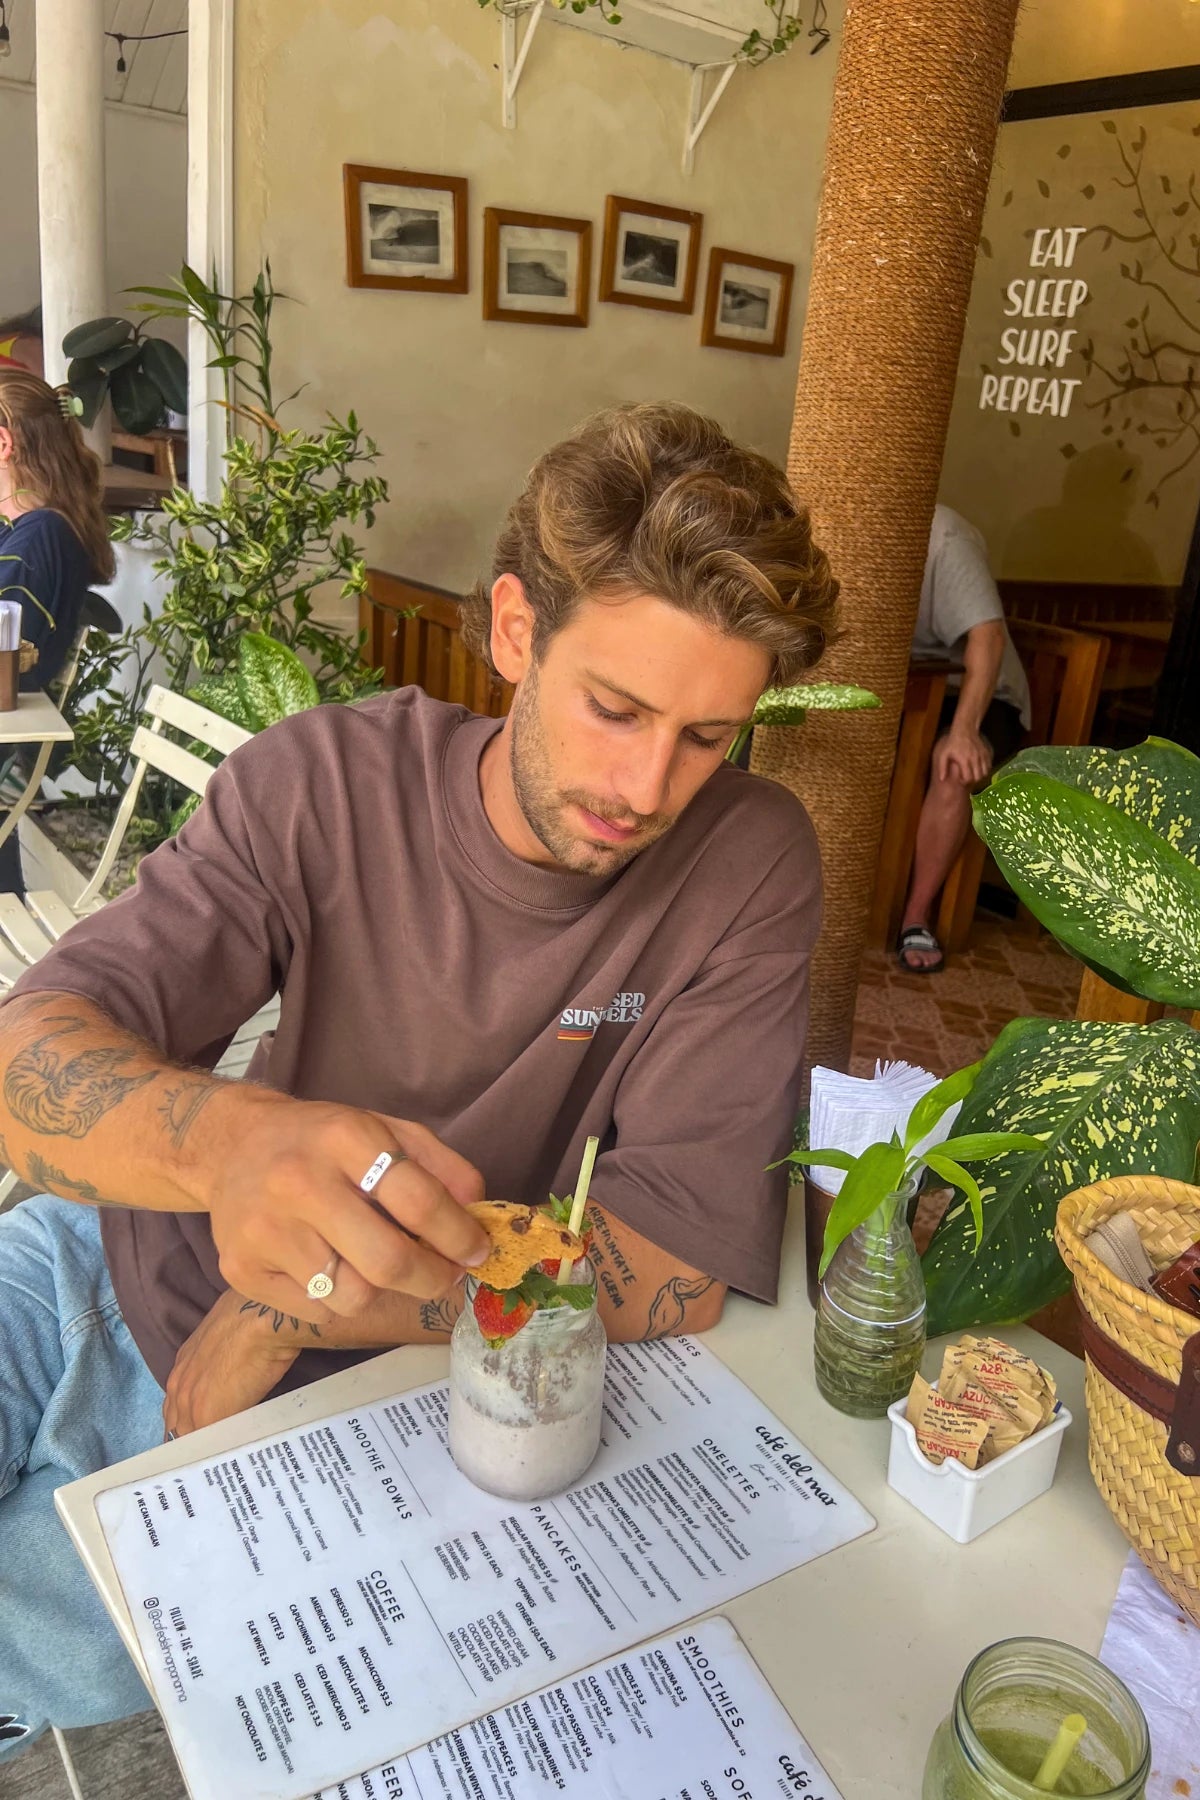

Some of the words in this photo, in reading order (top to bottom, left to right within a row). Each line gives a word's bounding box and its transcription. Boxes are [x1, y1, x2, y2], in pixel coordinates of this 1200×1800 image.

[1029, 227, 1087, 268] EAT
[1003, 279, 1088, 318] SLEEP
[997, 327, 1078, 368] SURF
[979, 374, 1083, 417] REPEAT
[610, 992, 646, 1007] SED
[280, 1440, 294, 1458] BOCAS
[288, 1457, 302, 1473] BOWL
[322, 1426, 337, 1445] PURPLE
[332, 1443, 348, 1465] DREAMS
[752, 1422, 791, 1453] café
[779, 1450, 814, 1477] del
[802, 1476, 838, 1509] mar
[229, 1459, 245, 1484] TROPICAL
[239, 1483, 254, 1504] WINTER
[346, 1417, 385, 1472] SMOOTHIE
[379, 1476, 413, 1521] BOWLS
[669, 1451, 691, 1473] SPINACH
[686, 1472, 701, 1485] FETA
[696, 1484, 723, 1511] OMELETTE
[700, 1437, 761, 1500] OMELETTES
[136, 1497, 146, 1508] WE
[156, 1491, 170, 1511] VEGAN
[176, 1484, 195, 1518] VEGETARIAN
[641, 1463, 667, 1492] CARIBBEAN
[663, 1490, 688, 1518] OMELETTE
[139, 1507, 150, 1520] CAN
[143, 1518, 153, 1529] DO
[616, 1506, 642, 1535] OMELETTE
[146, 1526, 160, 1548] VEGAN
[452, 1537, 471, 1561] BANANA
[469, 1530, 487, 1551] FRUITS
[487, 1559, 504, 1578] EACH)
[507, 1515, 529, 1542] REGULAR
[523, 1540, 548, 1571] PANCAKES
[528, 1505, 582, 1573] PANCAKES
[433, 1544, 458, 1580] BLUEBERRIES
[442, 1541, 471, 1581] STRAWBERRIES
[498, 1519, 518, 1543] Pancakes
[515, 1547, 533, 1565] Maple
[526, 1563, 543, 1581] Syrup
[541, 1584, 558, 1604] Butter
[329, 1586, 350, 1618] ESPRESSO
[343, 1617, 354, 1627] $2
[368, 1569, 405, 1623] COFFEE
[512, 1577, 537, 1608] TOPPINGS
[662, 1580, 682, 1602] Coconut
[167, 1605, 187, 1633] FOLLOW
[245, 1619, 259, 1636] FLAT
[267, 1611, 281, 1632] LATTE
[275, 1630, 285, 1641] $3
[288, 1603, 313, 1646] CAPUCHINNO
[306, 1644, 317, 1655] $3
[308, 1594, 332, 1634] AMERICANO
[325, 1632, 336, 1642] $3
[495, 1609, 517, 1638] WHIPPED
[511, 1636, 530, 1659] CREAM
[513, 1601, 535, 1627] OTHERS
[538, 1640, 556, 1662] EACH)
[145, 1606, 191, 1705] @cafedelmarpanama
[178, 1636, 194, 1652] TAG
[251, 1634, 267, 1658] WHITE
[260, 1655, 271, 1666] $4
[446, 1630, 467, 1660] NUTELLA
[456, 1626, 483, 1664] CHOCOLATE
[476, 1662, 494, 1684] SYRUP
[466, 1621, 489, 1654] COCONUT
[483, 1652, 502, 1676] FLAKES
[475, 1617, 494, 1640] SLICED
[487, 1638, 512, 1671] ALMONDS
[485, 1613, 512, 1651] CHOCOLATE
[506, 1648, 523, 1668] CHIPS
[184, 1654, 204, 1681] SHARE
[292, 1671, 307, 1690] ICED
[314, 1662, 329, 1680] ICED
[336, 1654, 356, 1684] MATCHA
[349, 1682, 366, 1705] LATTE
[358, 1703, 370, 1715] $4
[357, 1645, 385, 1692] MOCHACCINO
[379, 1690, 393, 1707] $3.5
[618, 1662, 639, 1690] NICOLE
[632, 1688, 647, 1706] $3.5
[652, 1648, 679, 1686] CAROLINA
[673, 1685, 688, 1702] $3.5
[681, 1635, 745, 1729] SMOOTHIES
[234, 1693, 248, 1711] HOT
[271, 1680, 288, 1708] FRAPPE
[281, 1706, 295, 1724] $5.5
[299, 1687, 316, 1711] LATTE
[321, 1678, 347, 1722] AMERICANO
[586, 1674, 608, 1706] CLASICO
[601, 1705, 613, 1717] $4
[240, 1709, 263, 1753] CHOCOLATE
[268, 1723, 282, 1743] CREAM
[270, 1705, 284, 1727] COFFEE
[310, 1714, 323, 1728] 3.5
[340, 1720, 351, 1732] $3
[553, 1687, 572, 1714] BOCAS
[565, 1713, 587, 1747] PASSION
[581, 1746, 593, 1758] $4
[641, 1724, 655, 1740] Lime
[255, 1750, 267, 1763] $3
[485, 1714, 502, 1741] GREEN
[496, 1740, 513, 1766] PEACE
[506, 1765, 517, 1777] $5
[519, 1700, 540, 1732] YELLOW
[533, 1731, 560, 1778] SUBMARINE
[554, 1777, 566, 1790] $4
[723, 1767, 753, 1800] SOF
[777, 1754, 813, 1791] café
